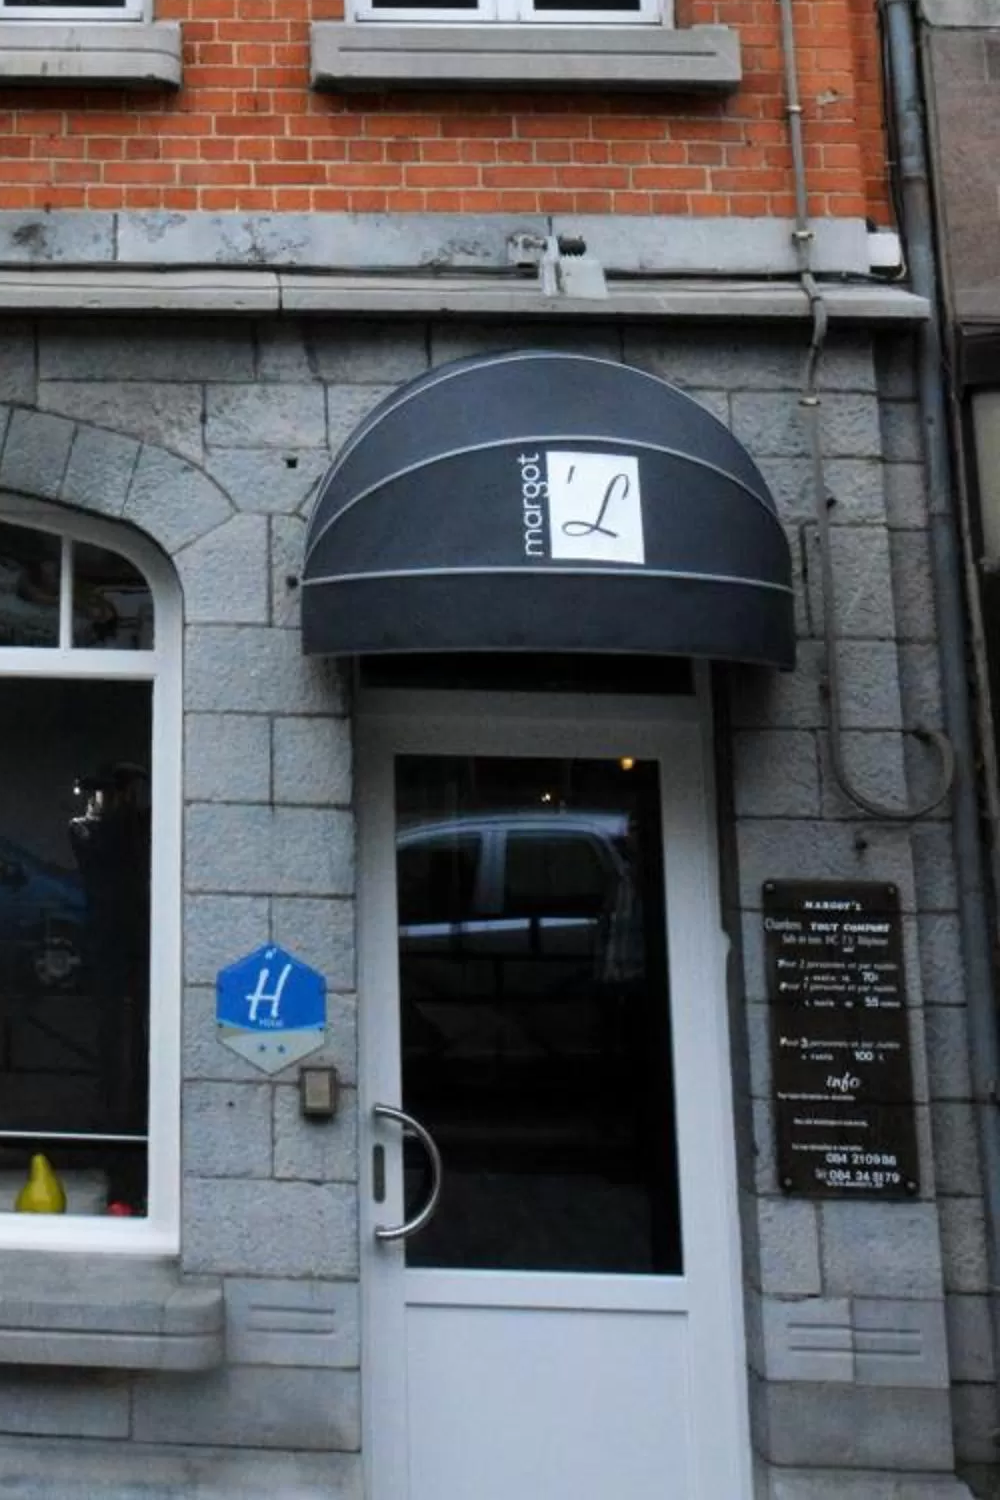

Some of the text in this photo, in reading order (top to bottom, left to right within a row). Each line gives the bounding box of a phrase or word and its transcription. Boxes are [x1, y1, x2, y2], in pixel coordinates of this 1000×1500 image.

[517, 452, 549, 557] margot
[244, 963, 293, 1022] H
[854, 1051, 874, 1062] 100
